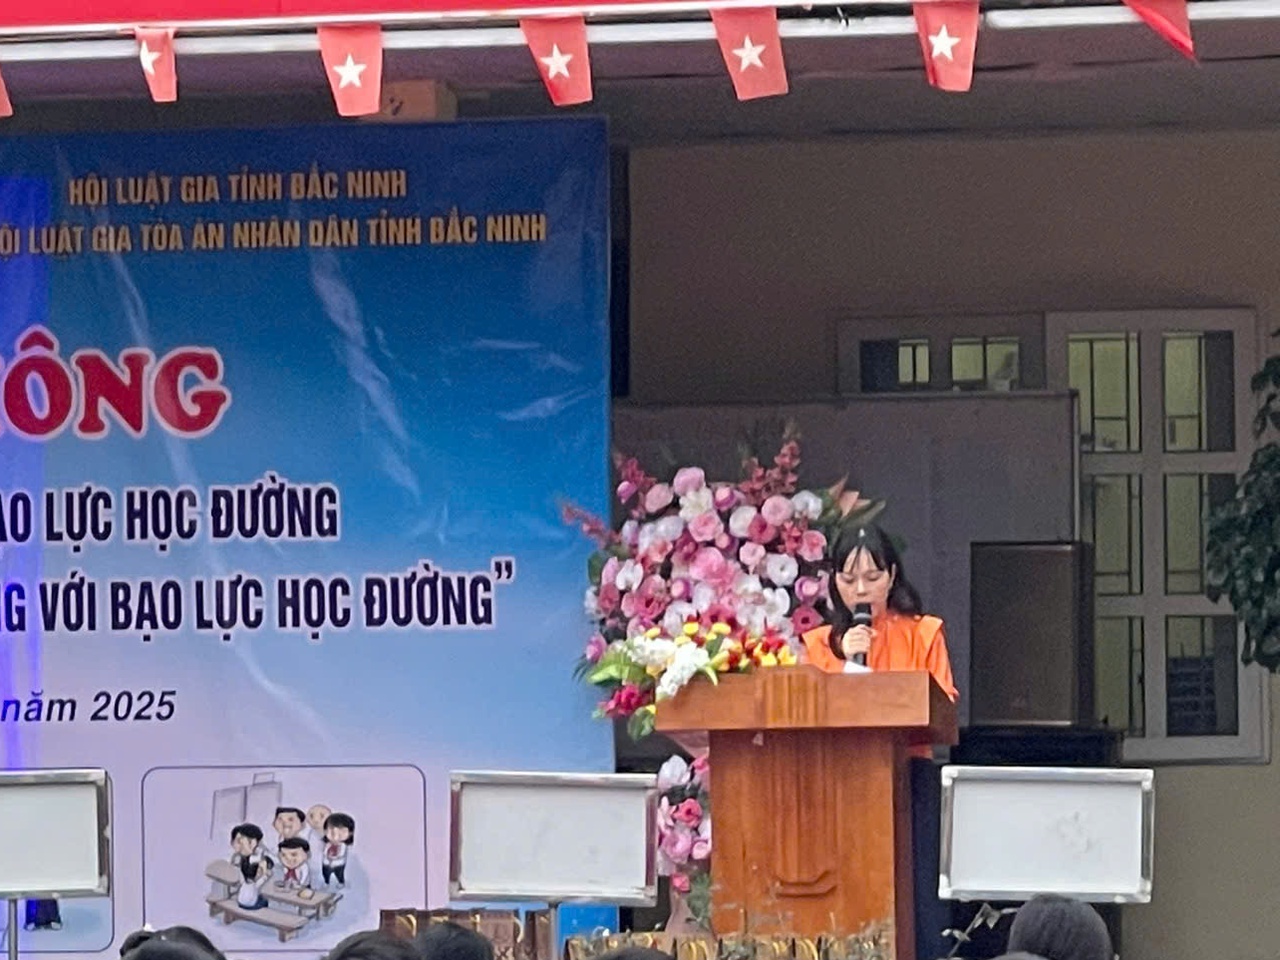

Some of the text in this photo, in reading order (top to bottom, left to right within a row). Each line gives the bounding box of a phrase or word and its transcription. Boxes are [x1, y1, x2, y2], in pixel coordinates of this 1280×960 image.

[69, 161, 407, 211] HỘI LUẬT GIA TỈNH BẮC NINH
[29, 220, 84, 259] LUẬT
[91, 225, 132, 252] GIA
[233, 215, 301, 248] NHÂN
[308, 213, 359, 247] DÂN
[367, 208, 421, 245] TỈNH
[429, 205, 478, 244] BẮC
[486, 214, 548, 243] NINH
[45, 486, 113, 552] LỰC
[126, 489, 197, 551] HỌC
[211, 475, 338, 538] ĐƯỜNG
[39, 571, 97, 631] VỚI
[111, 580, 183, 642] BẠO
[195, 575, 263, 641] LỰC
[278, 577, 351, 639] HỌC
[364, 560, 513, 627] ĐƯỜNG”
[0, 689, 77, 722] năm
[90, 690, 177, 722] 2025
